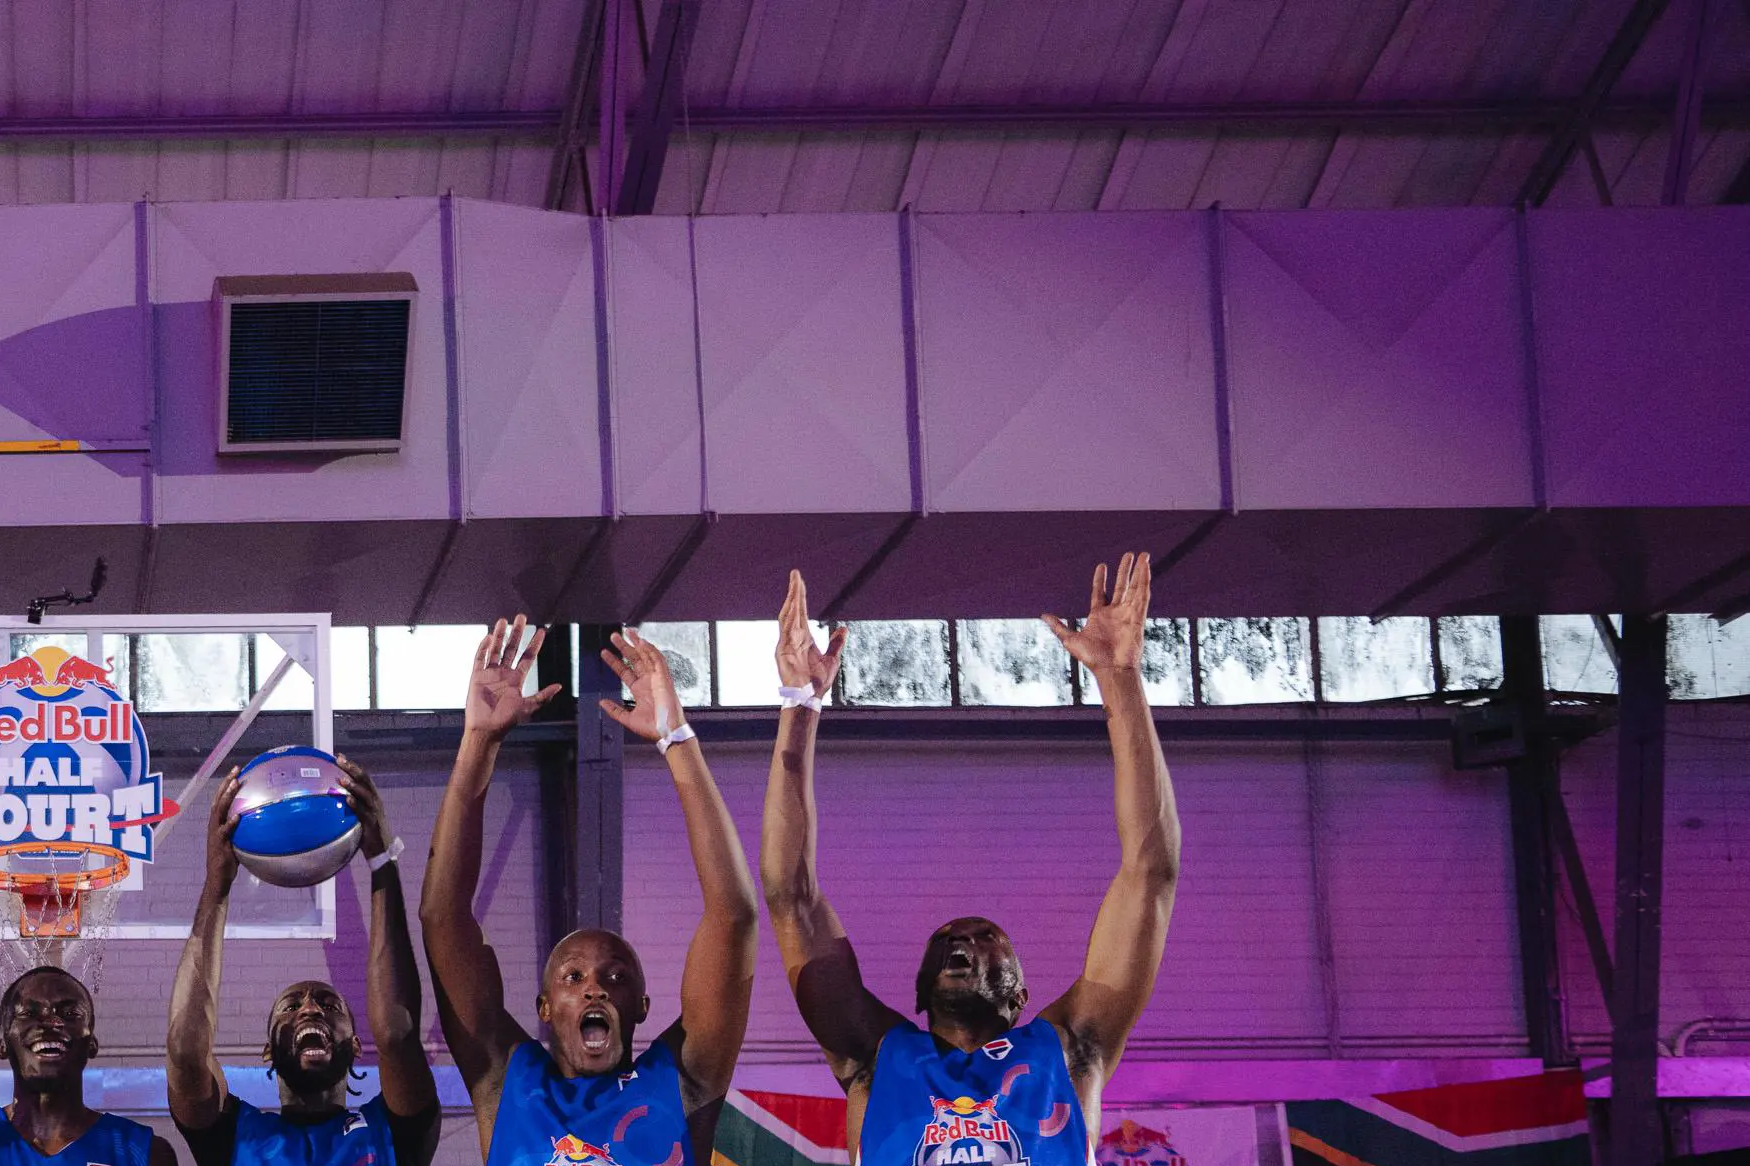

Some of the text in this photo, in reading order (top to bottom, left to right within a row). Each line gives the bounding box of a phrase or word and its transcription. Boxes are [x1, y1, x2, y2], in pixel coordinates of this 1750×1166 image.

[54, 703, 131, 741] Bull
[924, 1117, 1010, 1145] Red Bull
